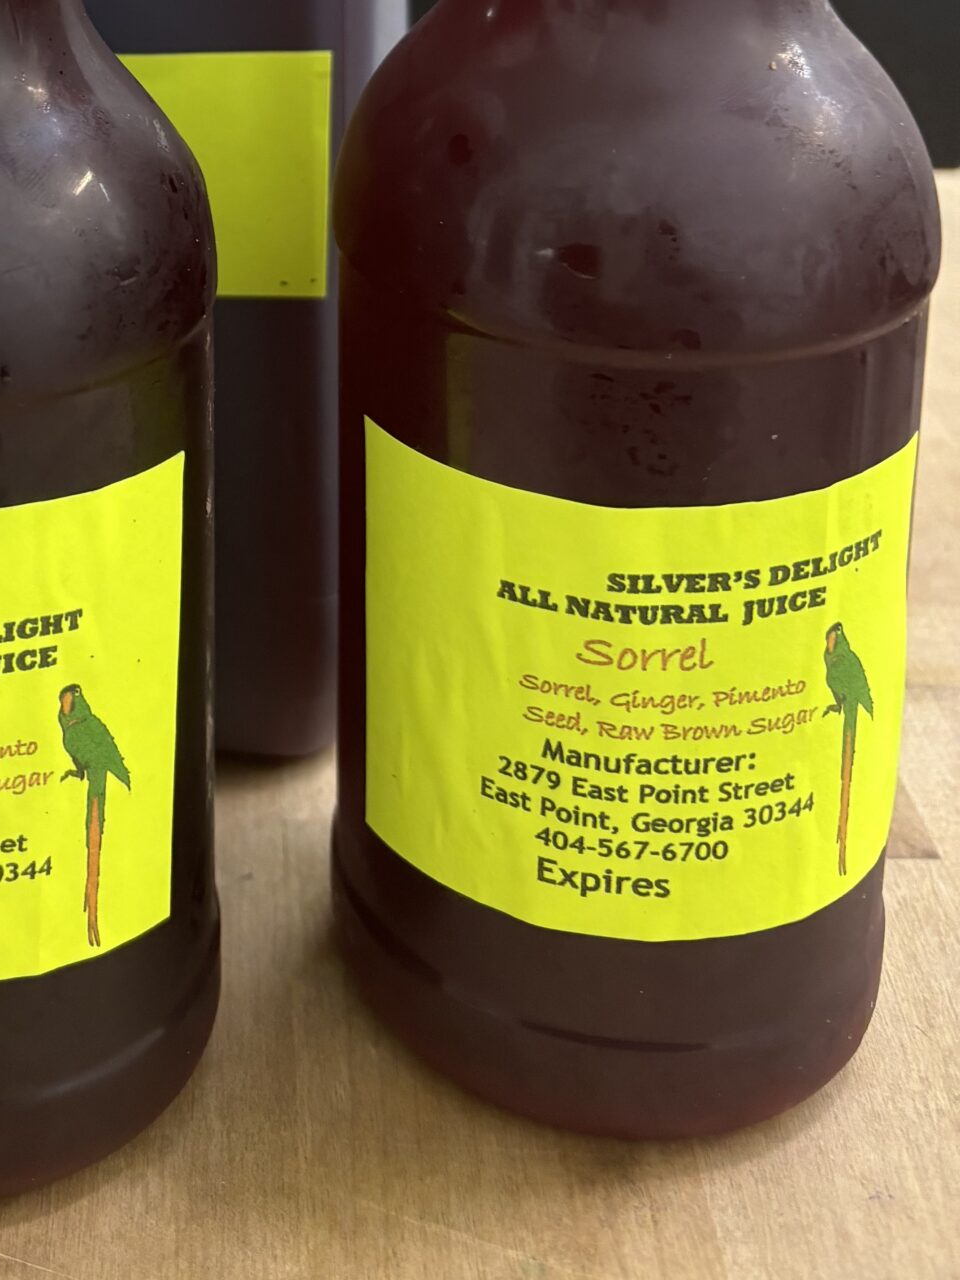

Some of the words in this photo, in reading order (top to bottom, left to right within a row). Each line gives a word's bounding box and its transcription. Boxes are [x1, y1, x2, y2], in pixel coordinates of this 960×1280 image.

[606, 568, 761, 594] SILVER'S
[768, 529, 882, 586] DELIGHT
[497, 579, 558, 613] ALL
[564, 594, 729, 625] NATURAL
[742, 586, 827, 625] JUICE
[576, 637, 714, 672] Sorrel
[519, 673, 600, 706] Sorrel,
[609, 689, 705, 714] Ginger,
[713, 678, 806, 708] Pimento
[522, 705, 588, 735] Seed,
[597, 720, 654, 741] Raw
[662, 721, 742, 741] Brown
[747, 704, 818, 736] Sugar
[541, 737, 756, 774] Manufacturer:
[498, 756, 561, 789] 2879
[572, 779, 628, 803] East
[639, 781, 709, 804] Point
[717, 771, 795, 802] Street
[480, 776, 531, 812] East
[540, 800, 619, 834] Point,
[631, 812, 733, 837] Georgia
[743, 792, 815, 828] 30344
[534, 826, 729, 861] 404-567-6700
[537, 855, 671, 898] Expires
